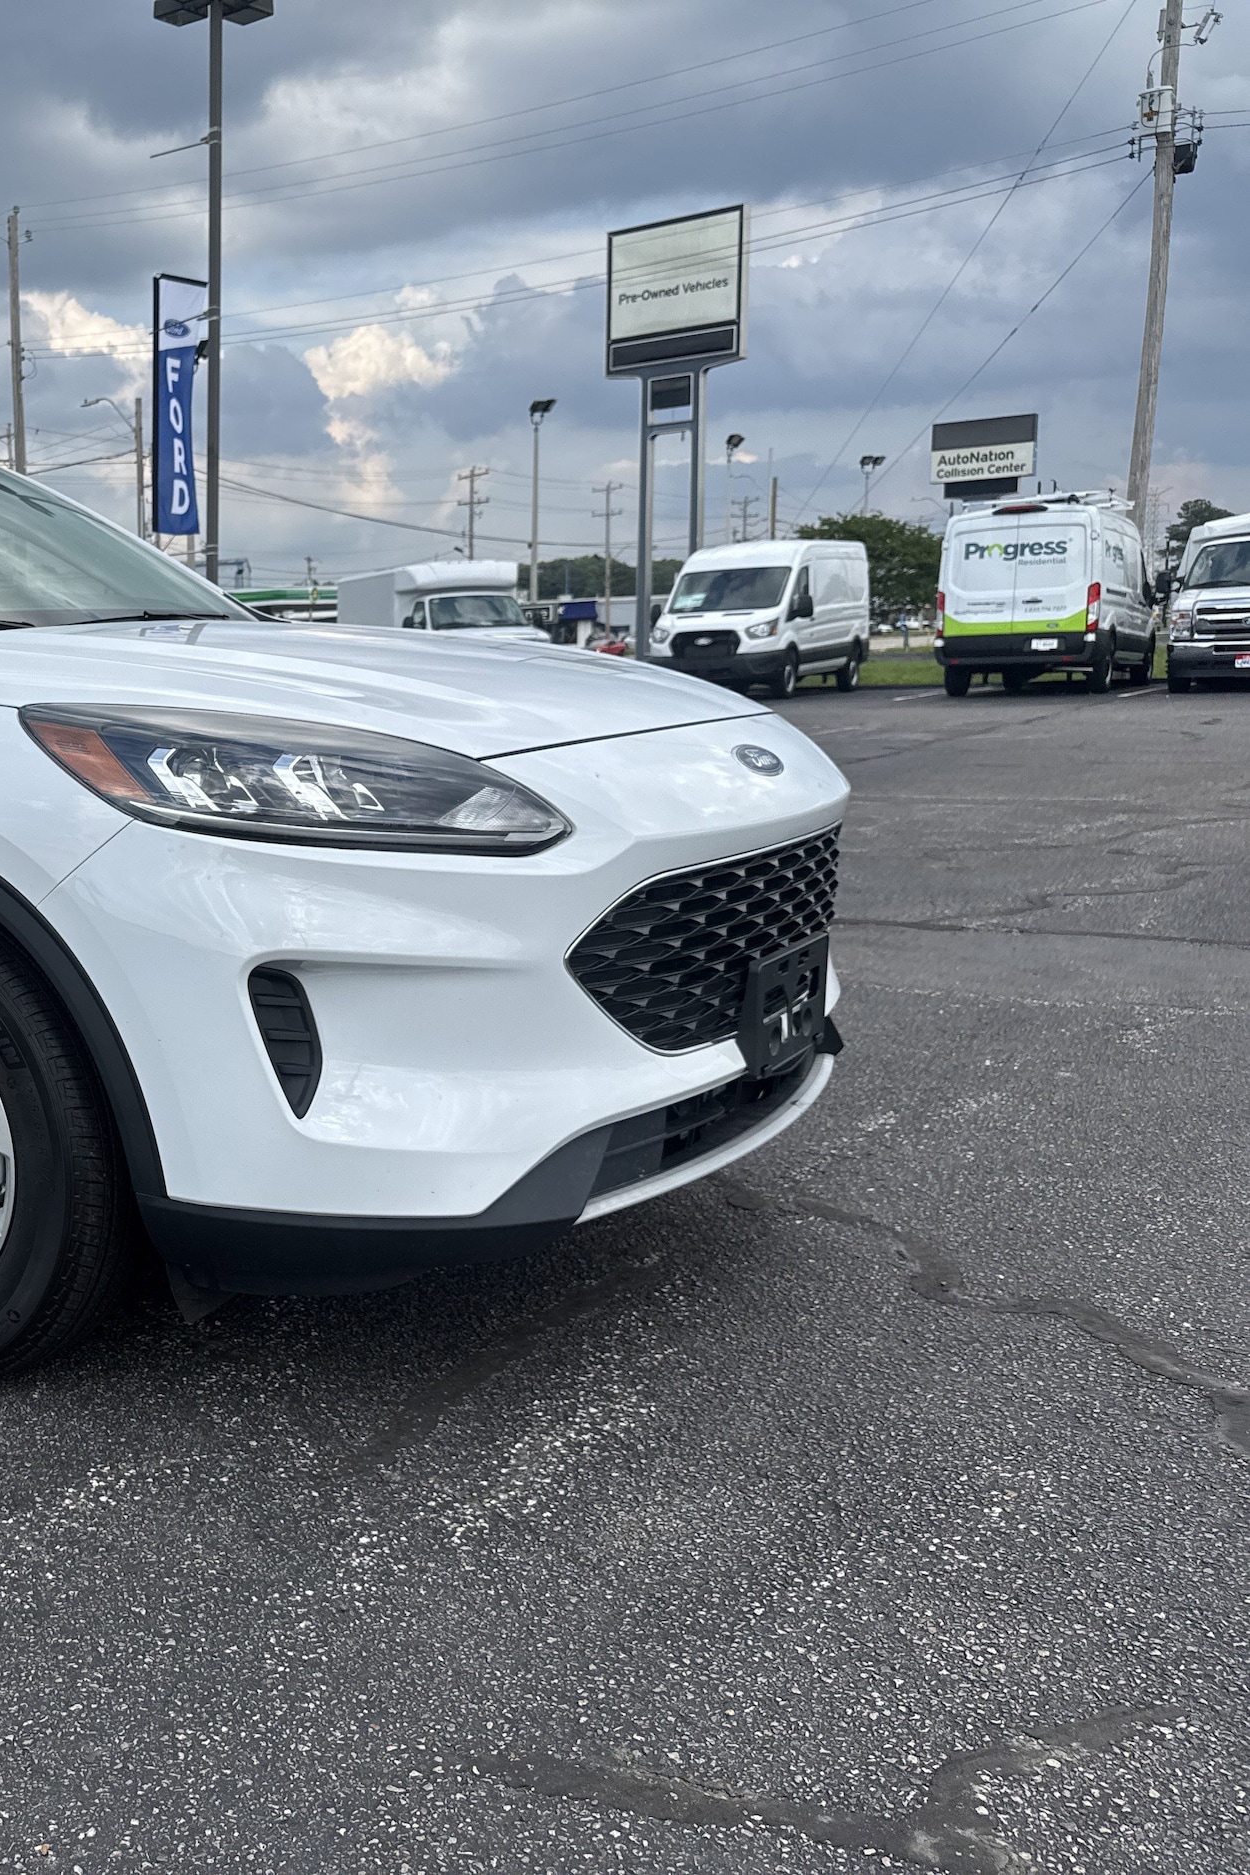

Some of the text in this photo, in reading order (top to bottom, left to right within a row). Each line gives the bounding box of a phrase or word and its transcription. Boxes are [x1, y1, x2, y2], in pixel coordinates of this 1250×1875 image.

[618, 277, 729, 305] Pre-Owned Vehicles
[165, 356, 190, 515] FORD
[937, 450, 1014, 467] AutoNation
[936, 463, 1027, 479] Collision Center
[963, 540, 1068, 561] Progress
[1018, 557, 1067, 566] Residential
